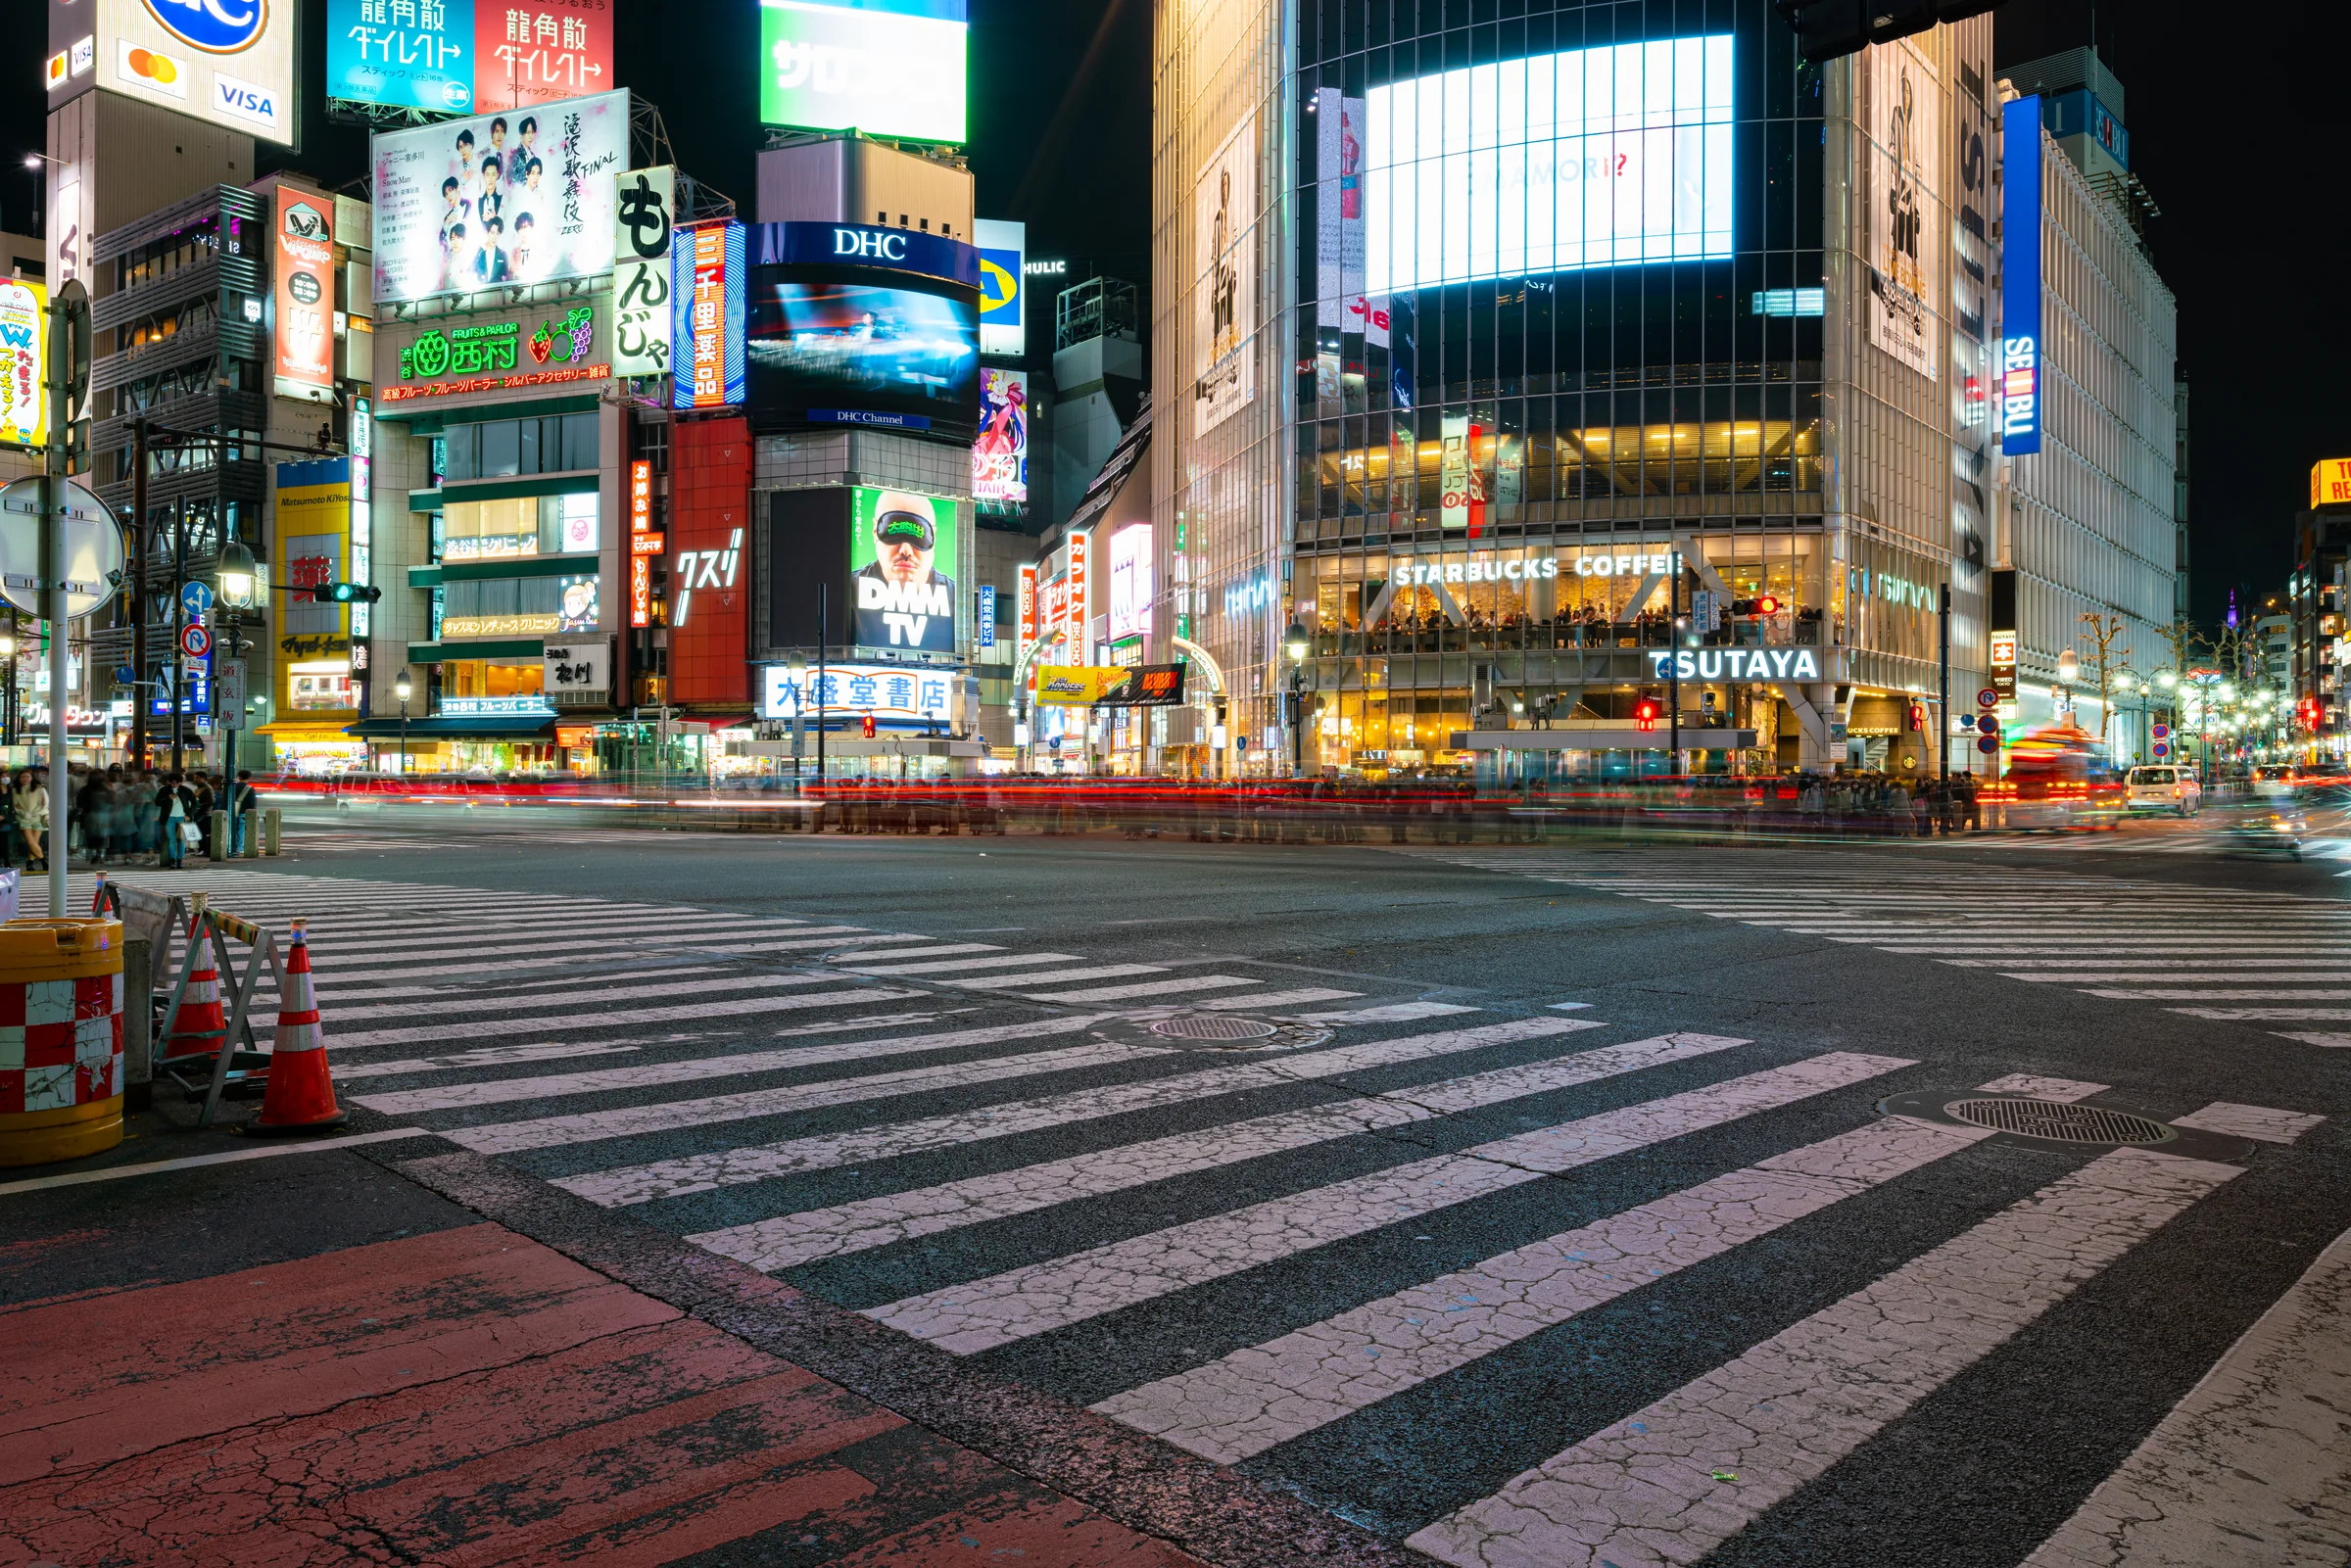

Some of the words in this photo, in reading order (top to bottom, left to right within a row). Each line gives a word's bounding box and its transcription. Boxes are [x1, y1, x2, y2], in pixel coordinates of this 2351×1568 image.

[505, 8, 587, 51] 龍角散
[73, 45, 91, 65] VISA
[348, 25, 461, 70] ダイレクト
[361, 66, 406, 78] スティック
[493, 44, 602, 87] ダイレクト
[218, 82, 273, 117] VISA
[506, 83, 549, 96] スティック
[398, 176, 411, 186] Man
[581, 151, 619, 178] FINAL
[560, 223, 585, 235] ZERO
[834, 228, 905, 261] DHC
[618, 174, 670, 369] もんじゃ
[1024, 261, 1066, 275] HULIC
[695, 235, 719, 396] 三千里薬品
[453, 337, 516, 374] 西村
[2004, 336, 2035, 437] SEIBU
[838, 411, 860, 423] DHC
[862, 412, 903, 425] Channel
[281, 495, 325, 506] Matsumoto
[674, 528, 744, 627] クスリ
[1072, 543, 1085, 613] カラオケ
[1395, 557, 1558, 586] STARBUCKS
[1575, 554, 1683, 577] COFFEE
[858, 576, 951, 616] DMM
[884, 612, 928, 646] TV
[1072, 640, 1080, 666] ECHO
[1648, 649, 1818, 679] TSUTAYA
[1994, 643, 2012, 661] 本
[222, 665, 235, 722] 道玄坂
[777, 673, 945, 710] 大盛堂書店
